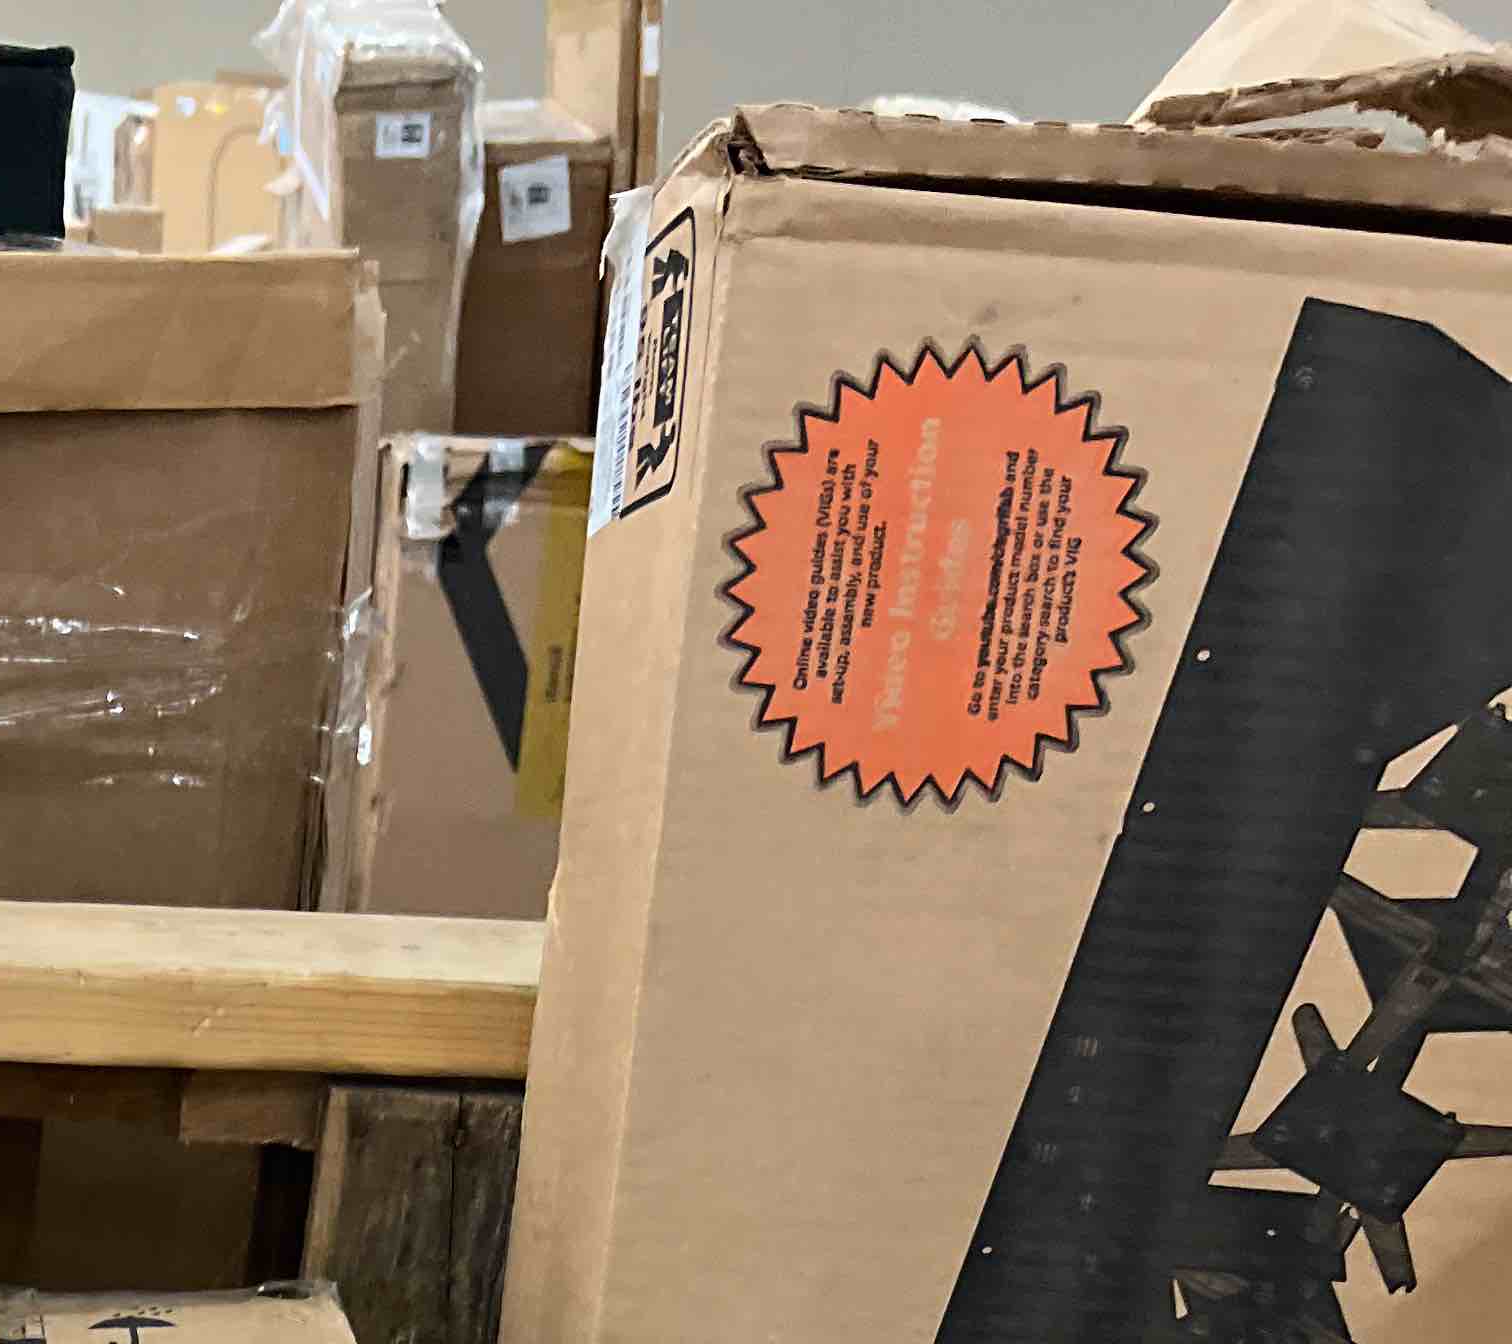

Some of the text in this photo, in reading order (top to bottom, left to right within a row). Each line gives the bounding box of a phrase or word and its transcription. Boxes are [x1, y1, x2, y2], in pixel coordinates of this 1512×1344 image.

[792, 448, 839, 690] Online video guides are
[816, 464, 856, 678] available you with
[851, 438, 879, 566] and your
[1005, 451, 1019, 482] and
[861, 593, 875, 628] new
[873, 417, 942, 731] Video Instruction
[988, 448, 1038, 721] enter your product model number
[1005, 589, 1035, 704] into the search
[1027, 476, 1071, 700] category search find your
